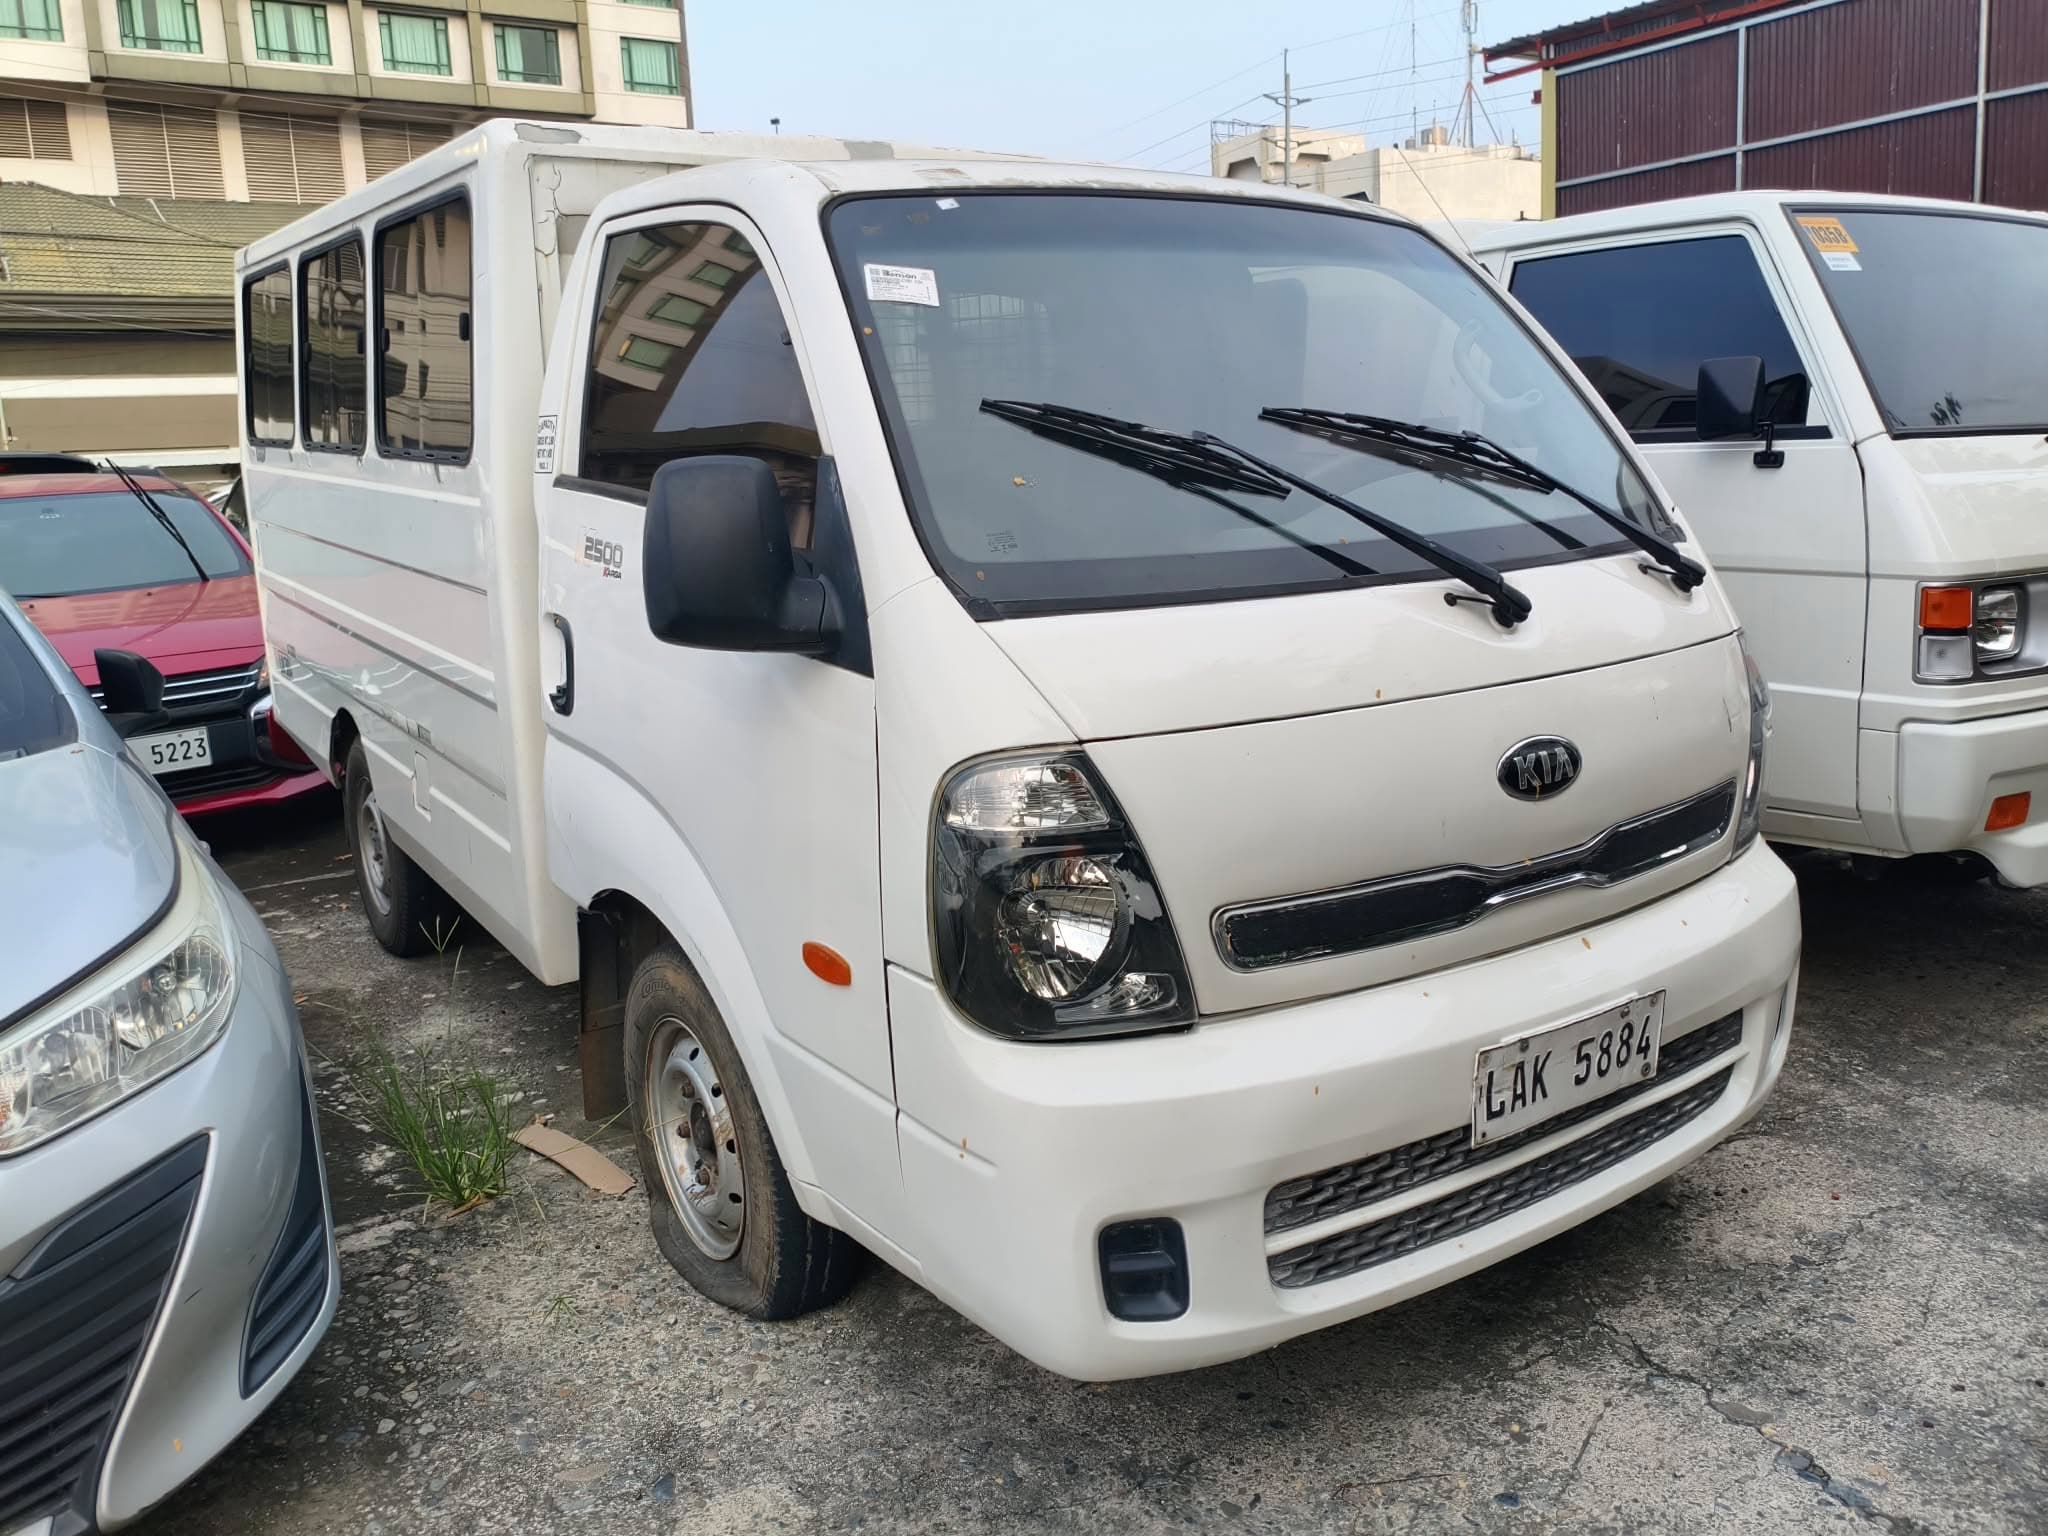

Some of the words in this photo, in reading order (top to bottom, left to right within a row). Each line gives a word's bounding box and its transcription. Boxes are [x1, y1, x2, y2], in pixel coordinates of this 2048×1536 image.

[584, 535, 624, 569] 2500
[150, 737, 207, 765] 5223
[1513, 746, 1574, 790] KIA
[1486, 1049, 1552, 1121] LAK
[1574, 1015, 1651, 1086] 5884
